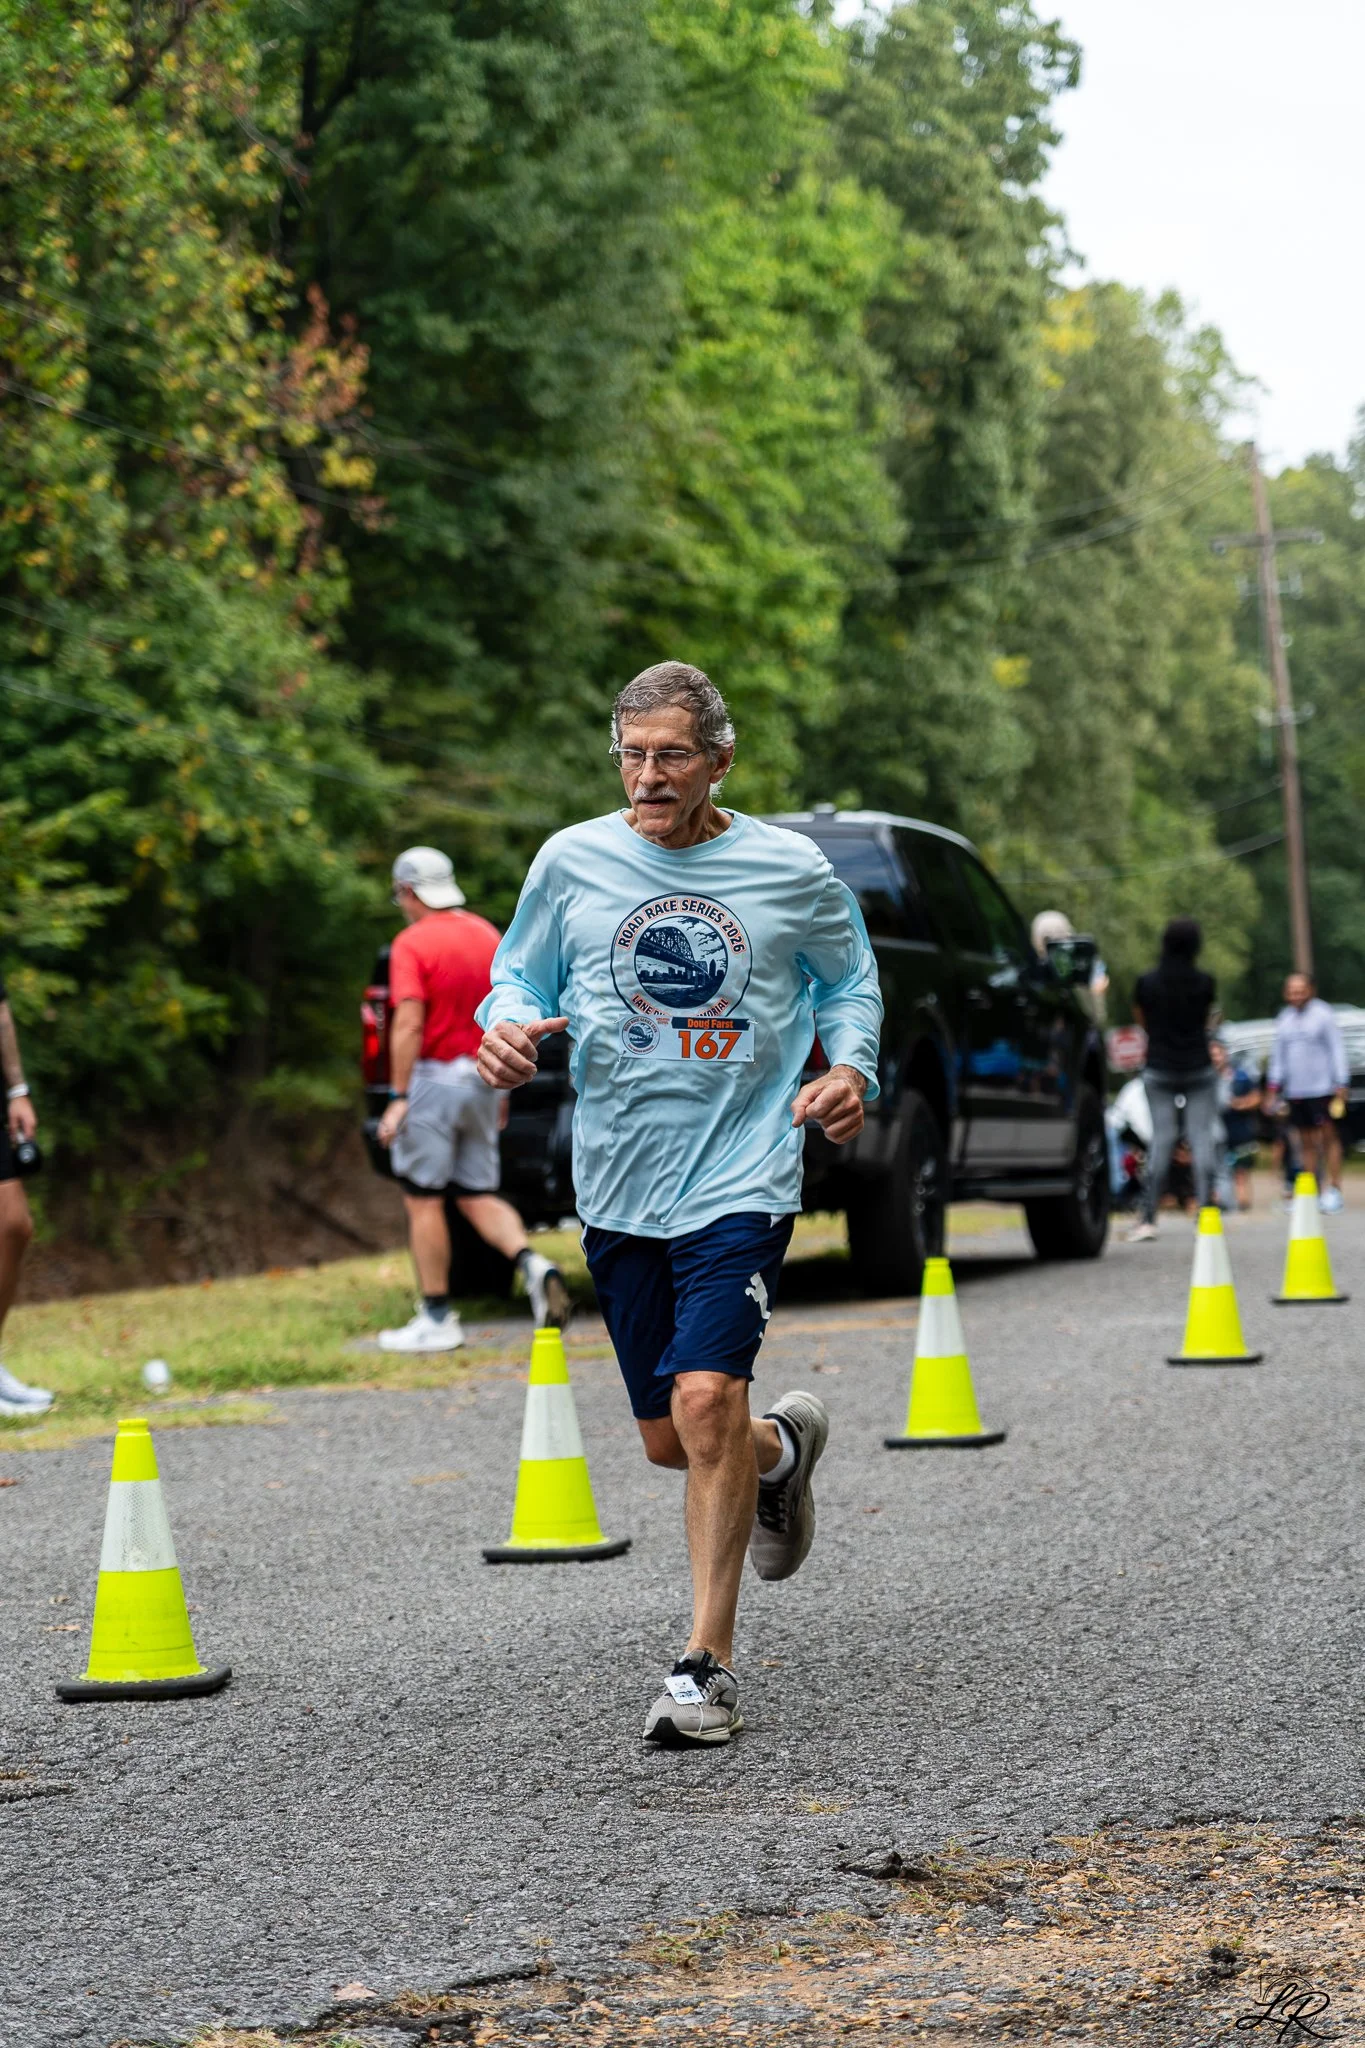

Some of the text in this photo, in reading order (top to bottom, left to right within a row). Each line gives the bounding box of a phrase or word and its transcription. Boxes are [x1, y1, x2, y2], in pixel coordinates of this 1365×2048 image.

[618, 899, 745, 952] ROAD RACE SERIES 2026
[632, 995, 653, 1014] LANE
[687, 1018, 710, 1029] Doug
[678, 1030, 743, 1060] 167
